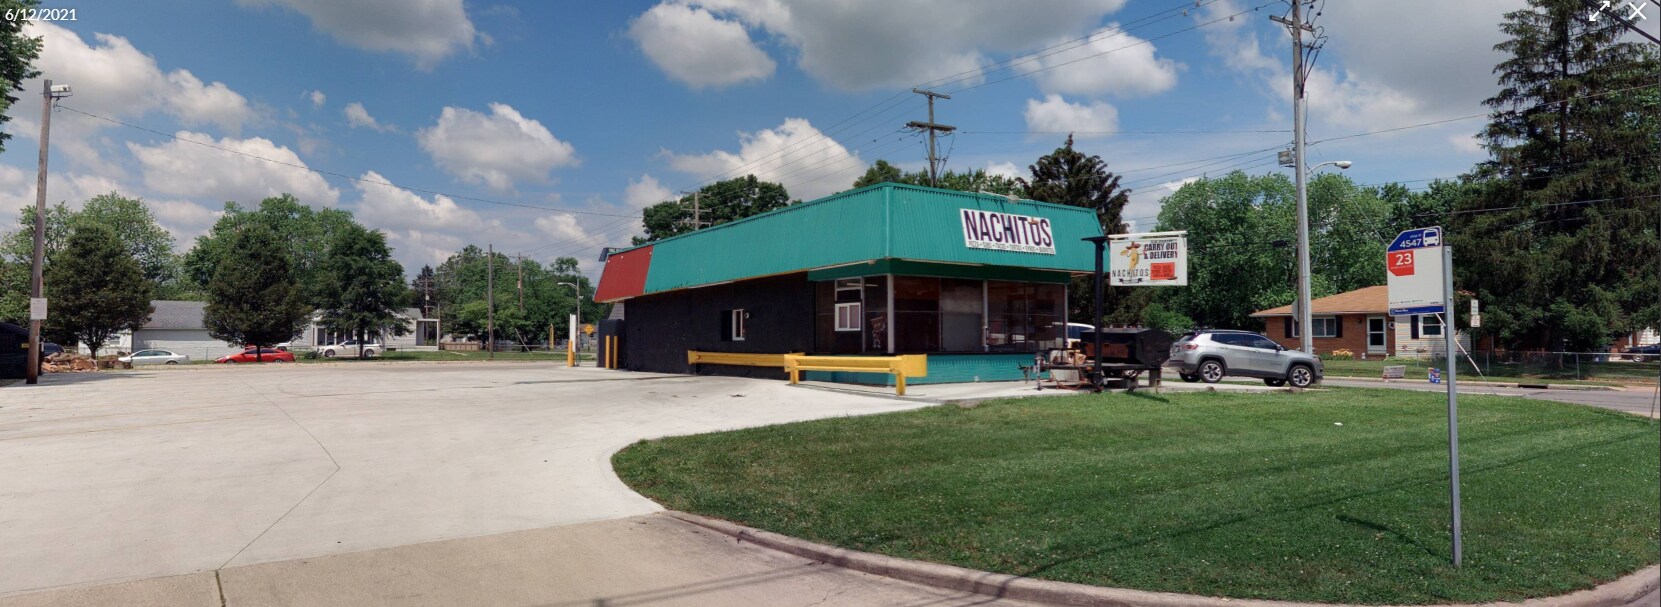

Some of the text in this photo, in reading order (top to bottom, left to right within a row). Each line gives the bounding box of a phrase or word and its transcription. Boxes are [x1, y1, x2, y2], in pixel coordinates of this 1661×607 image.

[963, 210, 1052, 247] NACHITOS
[1144, 243, 1165, 251] CARRY
[1400, 238, 1422, 248] 4547
[1150, 250, 1178, 259] DELIVERY
[1396, 253, 1412, 266] 23
